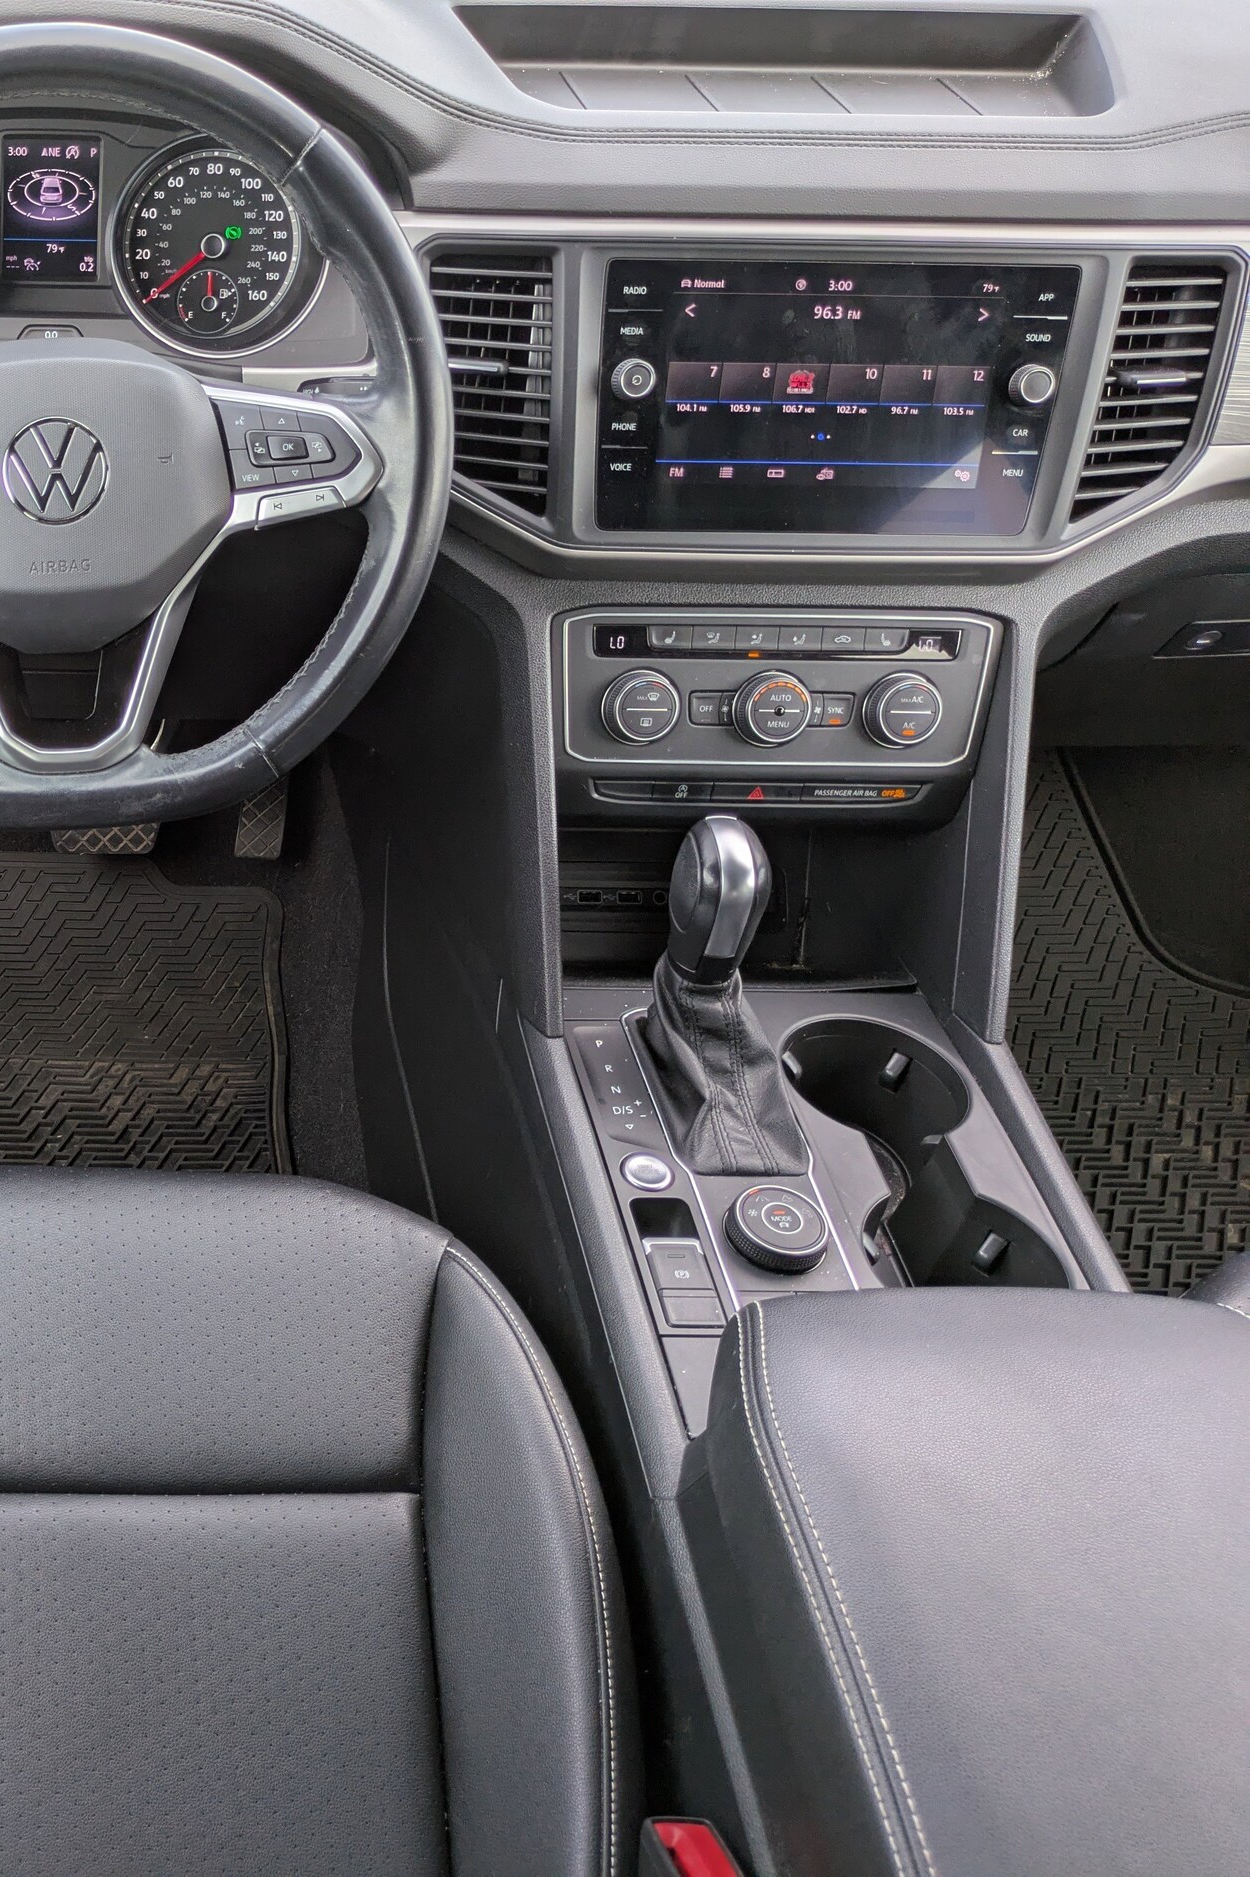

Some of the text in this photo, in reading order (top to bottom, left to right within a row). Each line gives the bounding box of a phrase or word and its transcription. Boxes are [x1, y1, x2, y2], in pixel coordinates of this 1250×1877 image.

[7, 146, 28, 157] 3:00
[90, 147, 97, 158] P
[188, 167, 200, 176] 70
[206, 163, 223, 175] 80
[229, 168, 241, 176] 90
[167, 176, 184, 188] 60
[240, 178, 261, 190] 100
[153, 191, 165, 200] 50
[200, 191, 212, 199] 120
[217, 191, 230, 199] 140
[261, 193, 274, 202] 110
[183, 197, 197, 205] 100
[232, 199, 245, 207] 160
[140, 207, 157, 219] 40
[171, 208, 181, 216] 80
[243, 211, 256, 219] 180
[264, 210, 284, 222] 120
[162, 223, 172, 231] 60
[248, 227, 263, 235] 200
[136, 229, 147, 237] 30
[272, 231, 287, 240] 130
[158, 241, 169, 249] 40
[250, 244, 264, 252] 220
[135, 248, 151, 260] 20
[267, 251, 287, 262] 140
[79, 262, 94, 272] 0.2
[139, 271, 149, 280] 10
[237, 276, 251, 284] 260
[265, 272, 280, 281] 150
[693, 279, 725, 289] Normal
[828, 280, 853, 291] 3:00
[150, 287, 159, 299] 0
[623, 286, 648, 295] RADIO
[247, 290, 268, 301] 160
[1038, 293, 1055, 302] APP
[188, 311, 194, 319] E
[221, 311, 227, 319] F
[813, 306, 861, 320] 96.3 FM
[620, 327, 644, 336] MEDIA
[1025, 333, 1051, 342] SOUND
[710, 366, 718, 378] 7
[762, 366, 771, 379] 8
[865, 368, 878, 380] 10
[922, 369, 932, 381] 11
[973, 370, 985, 382] 12
[676, 403, 698, 412] 104.1
[730, 404, 751, 413] 105.9
[782, 404, 803, 413] 106.7
[836, 405, 858, 414] 102.7
[890, 406, 909, 415] 96.7
[943, 407, 964, 416] 103.5
[611, 422, 637, 431] PHONE
[1012, 428, 1029, 437] CAR
[282, 443, 294, 451] OK
[609, 463, 632, 472] VOICE
[669, 467, 684, 477] FM
[1002, 469, 1024, 477] MENU
[241, 474, 260, 482] VIEW
[28, 558, 92, 576] AIRBAG
[770, 694, 792, 702] AUTO
[911, 695, 924, 704] A/C
[699, 705, 713, 713] OFF
[827, 705, 844, 714] SYNC
[767, 720, 790, 729] MENU
[675, 791, 688, 799] OFF
[814, 789, 853, 797] PASSENGER
[852, 789, 864, 797] AIR
[864, 790, 878, 798] BAG
[595, 1040, 603, 1048] P
[604, 1064, 613, 1073] R
[610, 1086, 621, 1094] N
